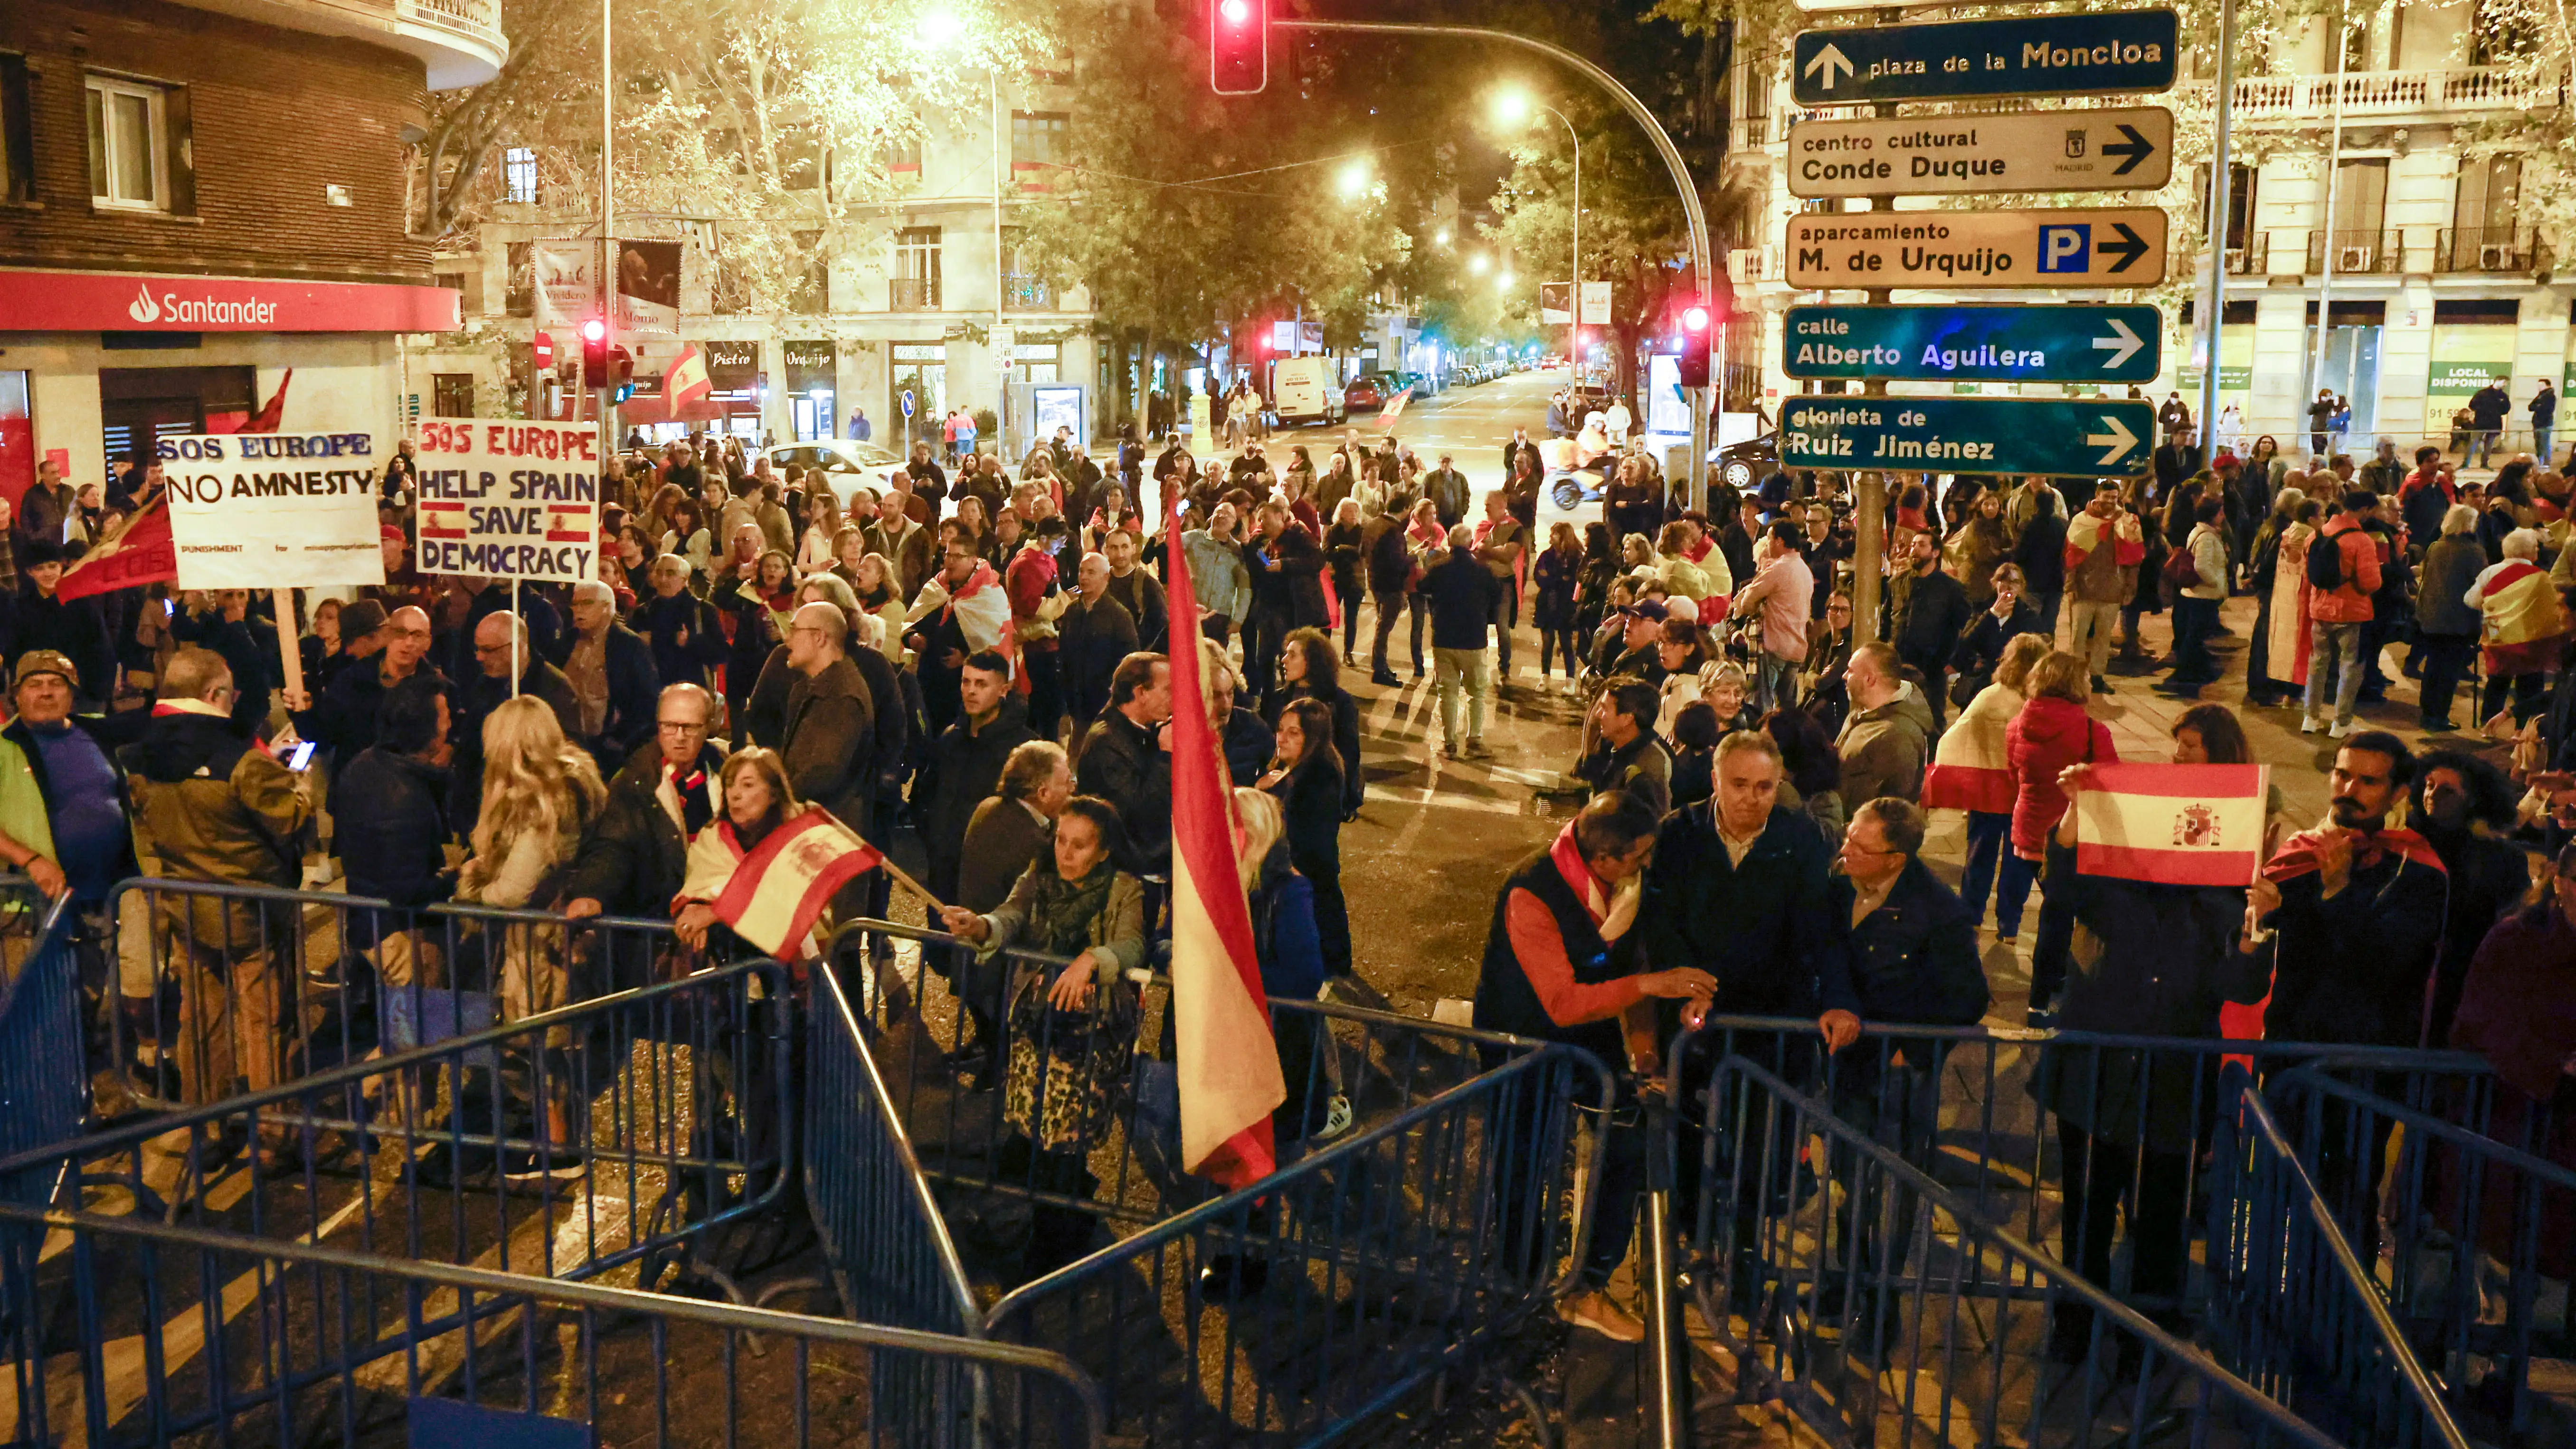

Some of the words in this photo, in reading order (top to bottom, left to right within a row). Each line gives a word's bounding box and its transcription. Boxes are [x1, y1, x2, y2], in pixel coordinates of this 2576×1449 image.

[1870, 58, 1926, 80] plaza
[1943, 56, 1970, 72] de
[1985, 53, 2006, 70] la
[2022, 39, 2161, 69] Moncloa
[1803, 134, 1873, 152] centro
[1887, 129, 1978, 149] cultural
[1802, 158, 1892, 180] Conde
[1911, 156, 2007, 180] Duque
[2054, 162, 2094, 172] MADRID
[1800, 223, 1950, 244] aparcamiento
[1799, 247, 1830, 272] M.
[1848, 250, 1883, 271] de
[1901, 246, 2013, 277] Urquijo
[2046, 228, 2082, 270] P
[163, 293, 277, 323] Santander
[623, 310, 659, 323] Momo
[1797, 318, 1850, 335] calle
[1796, 343, 1901, 365] Alberto
[1920, 344, 2046, 370] Aguilera
[2431, 378, 2494, 388] DISPONIB
[2449, 368, 2489, 378] LOCAL
[1791, 407, 1882, 427] glorieta
[1898, 410, 1926, 426] de
[2430, 408, 2442, 418] 91
[157, 438, 223, 460] SOS
[239, 434, 372, 458] EUROPE
[419, 422, 474, 454] SOS
[486, 426, 597, 461] EUROPE
[1792, 432, 1853, 456] Ruiz
[1873, 435, 1994, 460] Jiménez
[165, 474, 222, 503] NO
[231, 470, 374, 498] AMNESTY
[419, 470, 496, 498] HELP
[509, 470, 596, 502] SPAIN
[469, 506, 542, 534] SAVE
[181, 545, 243, 553] PUNISHMENT
[275, 544, 289, 552] for
[422, 540, 592, 579] DEMOCRACY
